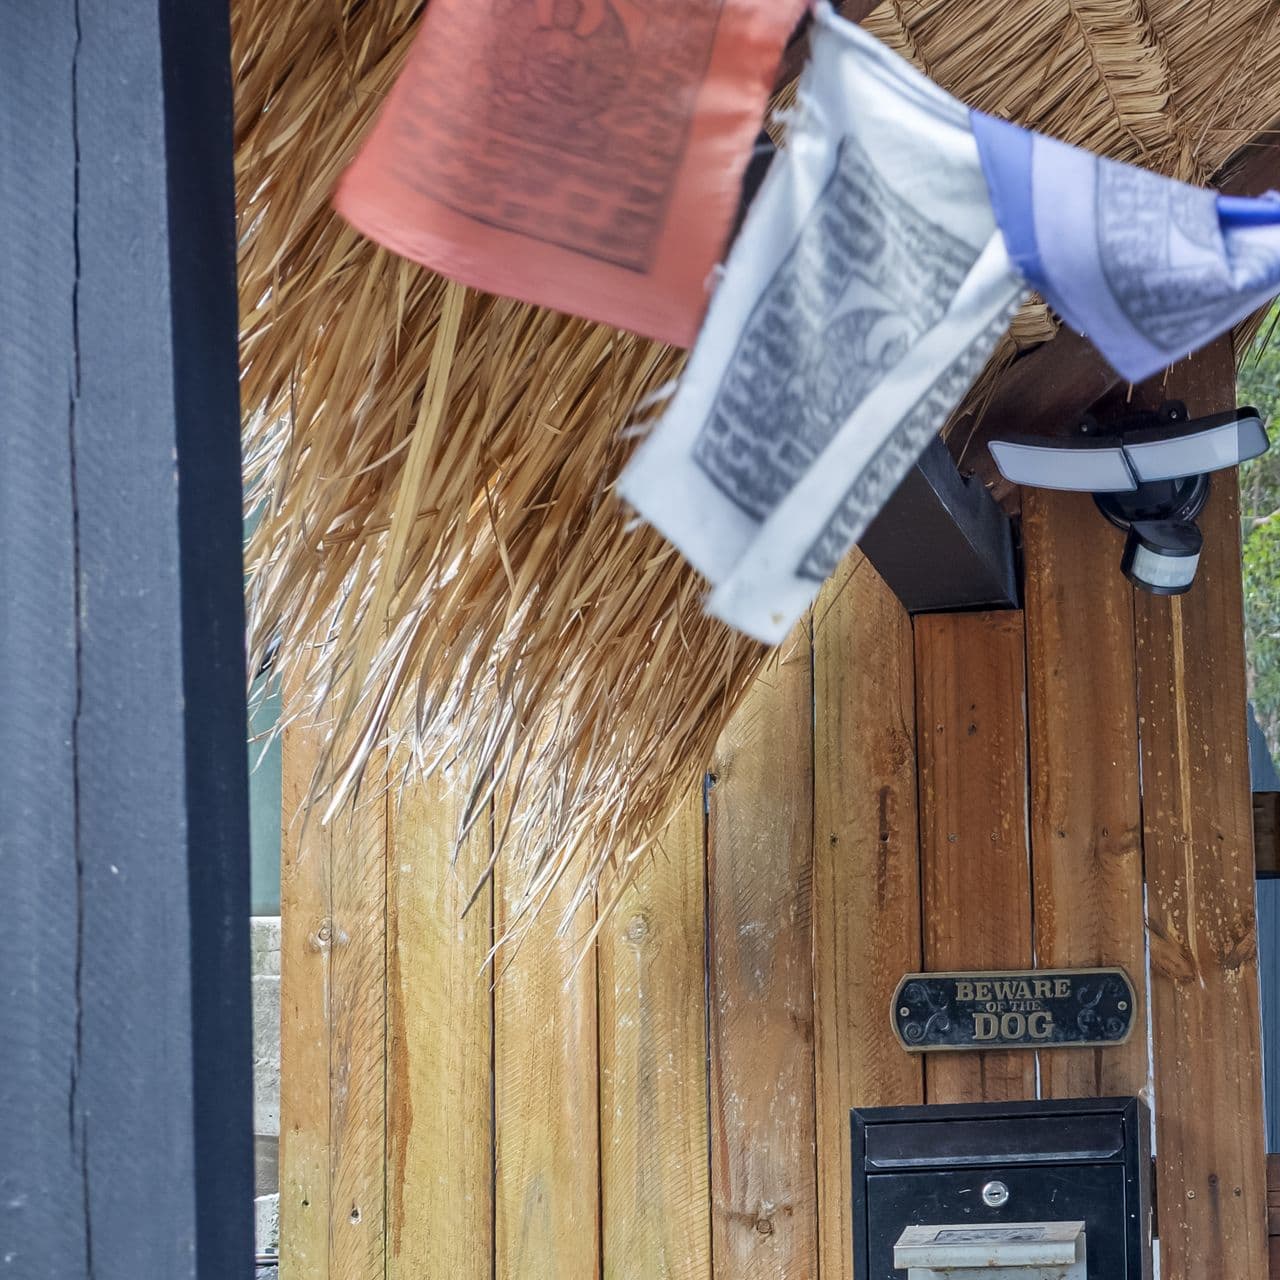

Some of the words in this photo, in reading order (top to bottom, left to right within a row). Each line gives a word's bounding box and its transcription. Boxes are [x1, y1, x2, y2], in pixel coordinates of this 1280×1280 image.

[955, 979, 1071, 1001] BEWARE
[985, 1001, 1004, 1013] OF
[1010, 1000, 1041, 1012] THE
[972, 1012, 1055, 1040] DOG
